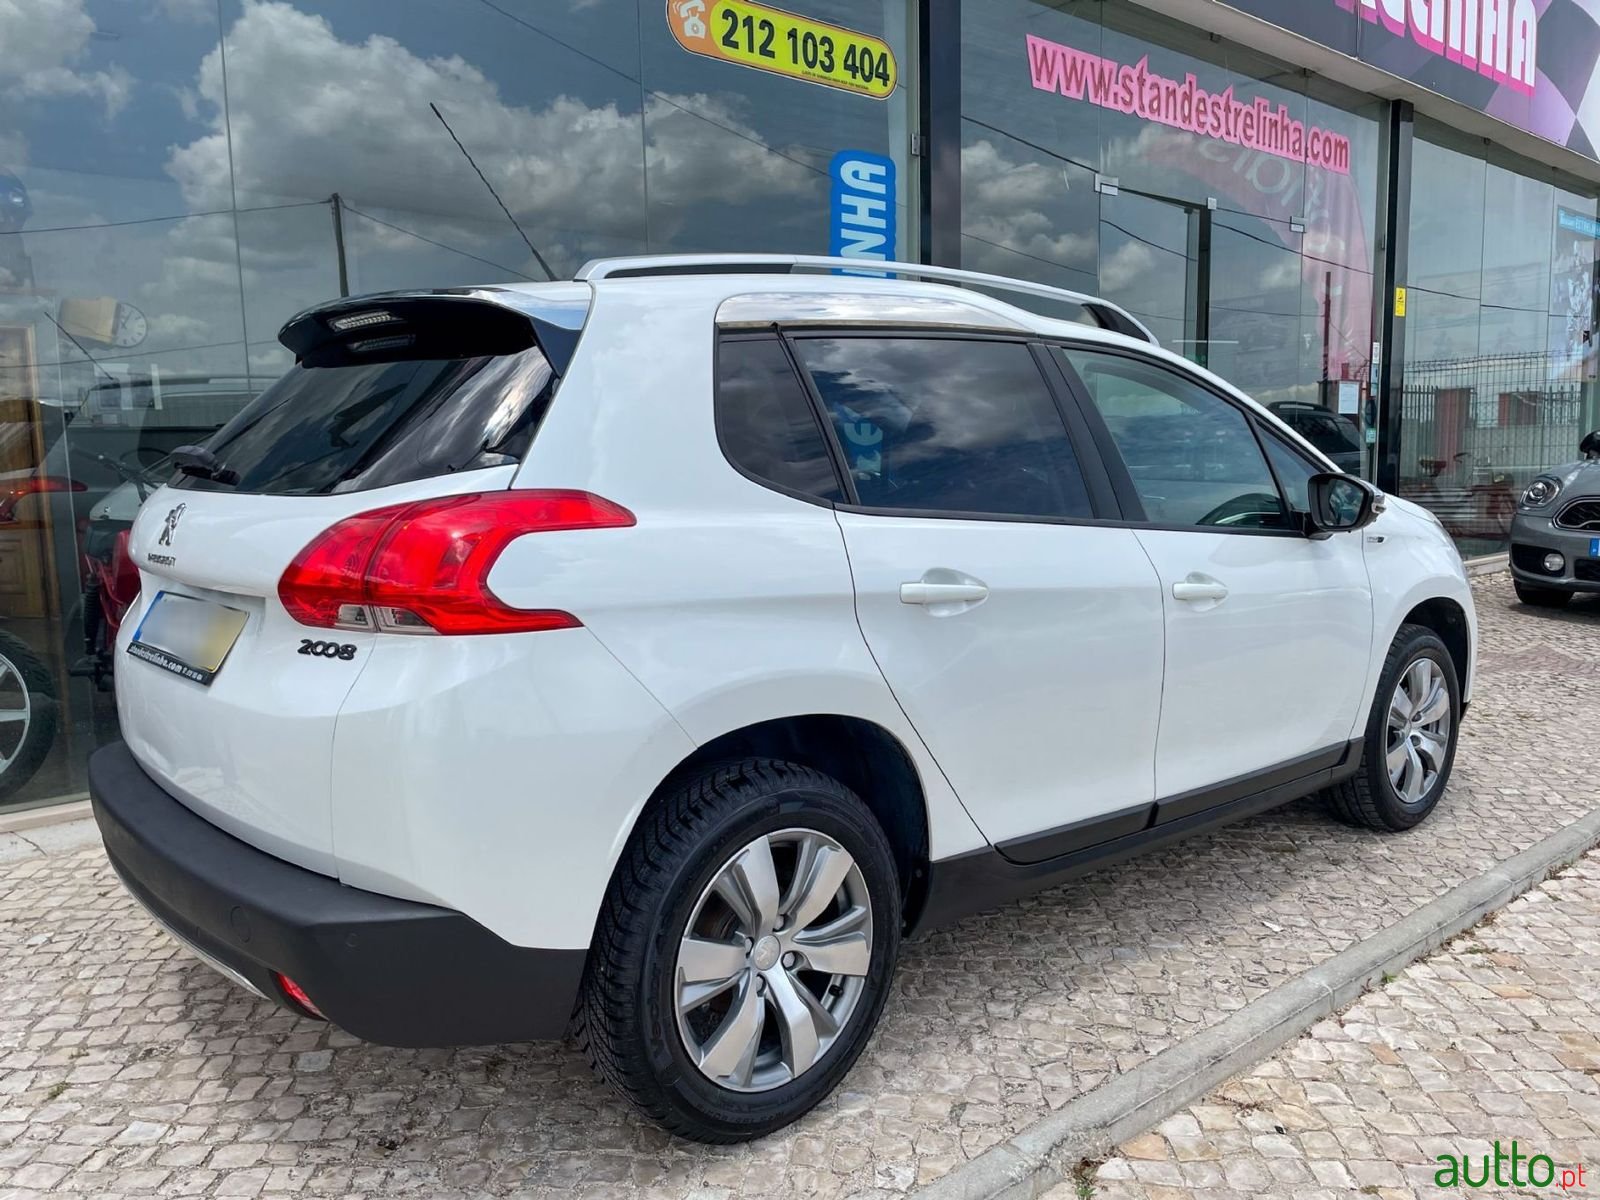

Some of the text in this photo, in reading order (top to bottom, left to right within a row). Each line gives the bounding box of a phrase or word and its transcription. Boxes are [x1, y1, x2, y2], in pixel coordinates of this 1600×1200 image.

[721, 9, 776, 59] 212
[787, 28, 835, 73] 103
[843, 44, 890, 87] 404
[1030, 42, 1349, 169] www.standestrelinha.com
[297, 639, 357, 660] 2008
